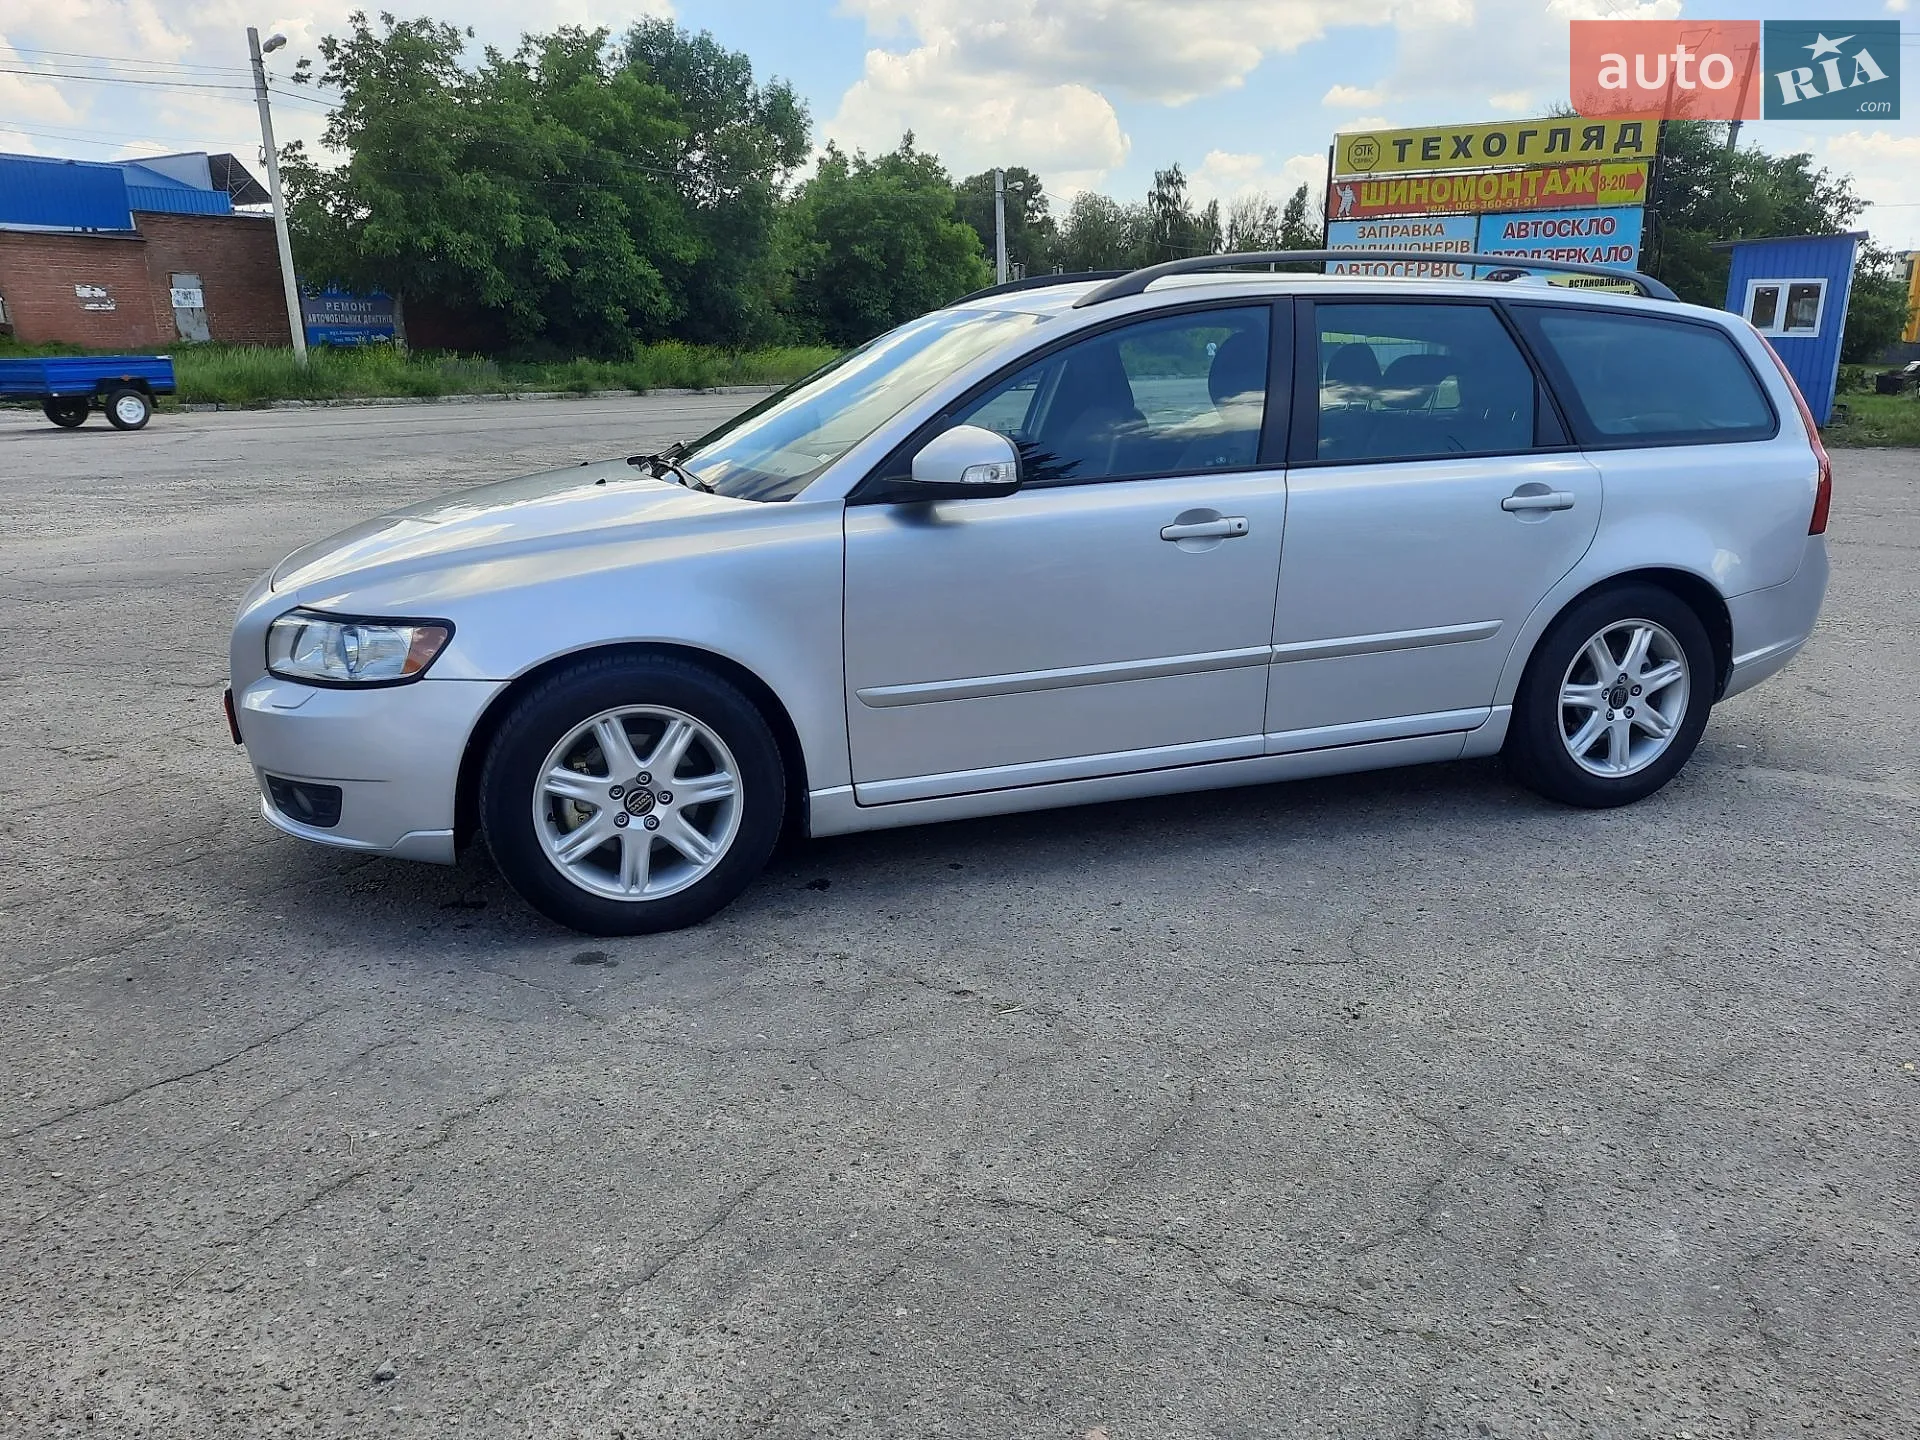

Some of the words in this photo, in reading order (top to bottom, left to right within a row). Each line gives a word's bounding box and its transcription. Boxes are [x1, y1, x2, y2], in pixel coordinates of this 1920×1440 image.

[1392, 121, 1643, 163] ТЕХОГЛЯД
[1360, 165, 1597, 207] ШИНОМОНТАЖ
[1599, 175, 1626, 192] 8-20
[1357, 223, 1445, 239] ЗАПРАВКА
[1502, 216, 1616, 239] АВТОСКЛО
[1483, 245, 1634, 264] ДЗЕРКАЛО
[1334, 262, 1465, 278] АВТОСЕРВІС
[325, 302, 374, 312] РЕМОНТ
